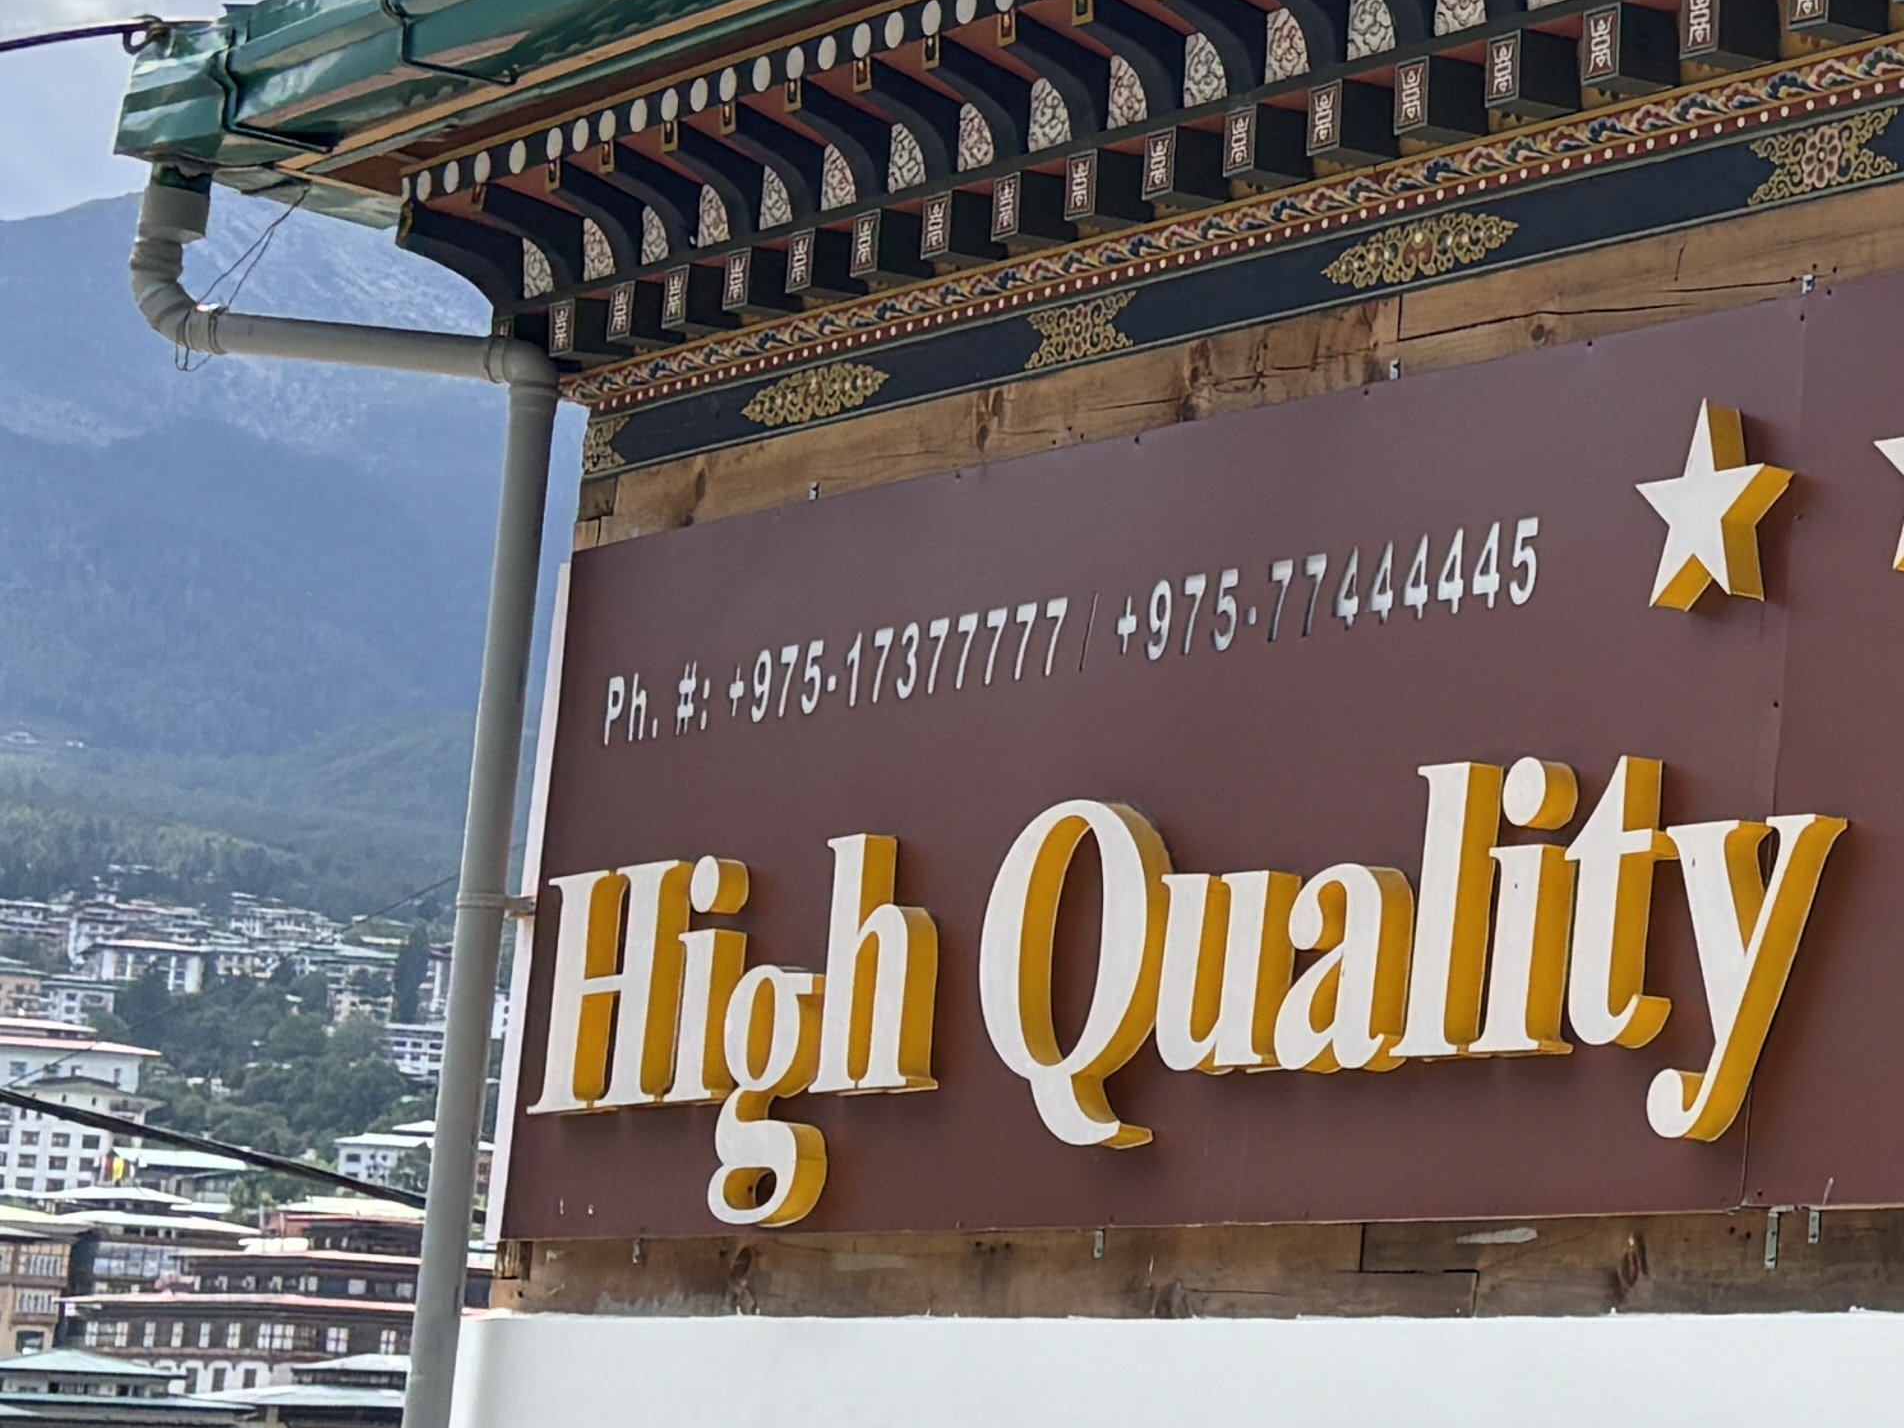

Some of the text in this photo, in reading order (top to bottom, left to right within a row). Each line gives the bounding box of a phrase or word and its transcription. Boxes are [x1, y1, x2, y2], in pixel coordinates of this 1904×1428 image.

[603, 672, 659, 747] Ph.
[676, 660, 711, 737] #:
[728, 596, 1069, 724] +975-17377777
[1116, 516, 1540, 661] +975-77444445
[527, 833, 939, 1227] High
[979, 754, 1848, 1149] Quality
